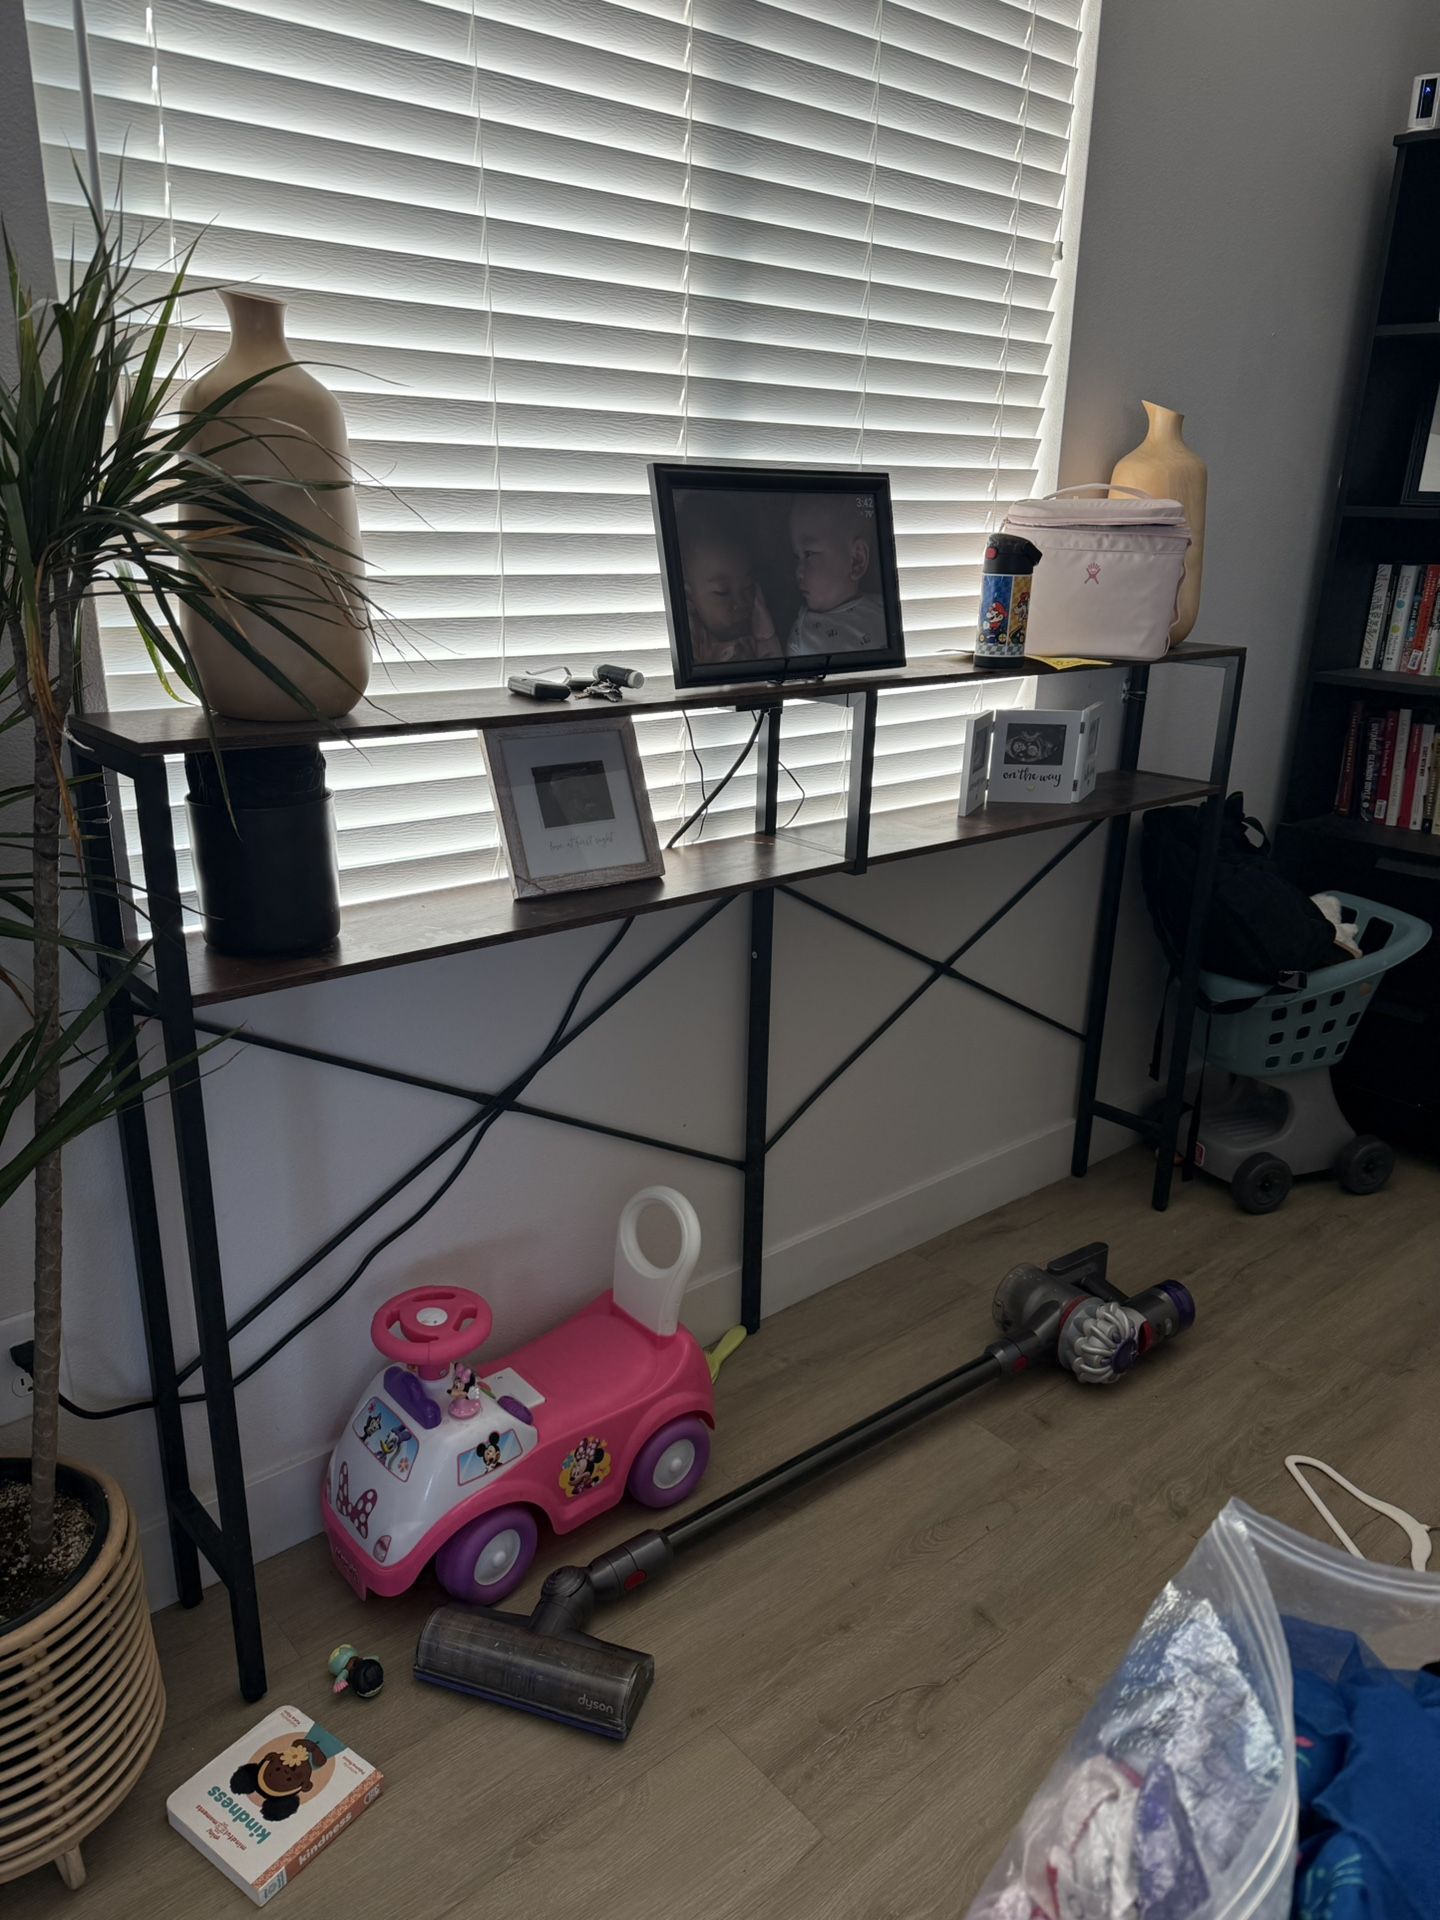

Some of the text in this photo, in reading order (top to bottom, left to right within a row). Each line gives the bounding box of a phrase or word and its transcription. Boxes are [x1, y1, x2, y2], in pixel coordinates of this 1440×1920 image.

[1002, 767, 1062, 788] on the way
[577, 1693, 614, 1715] dyson
[195, 1804, 247, 1851] mindful moments
[207, 1785, 272, 1845] kindness
[298, 1812, 353, 1865] kindness
